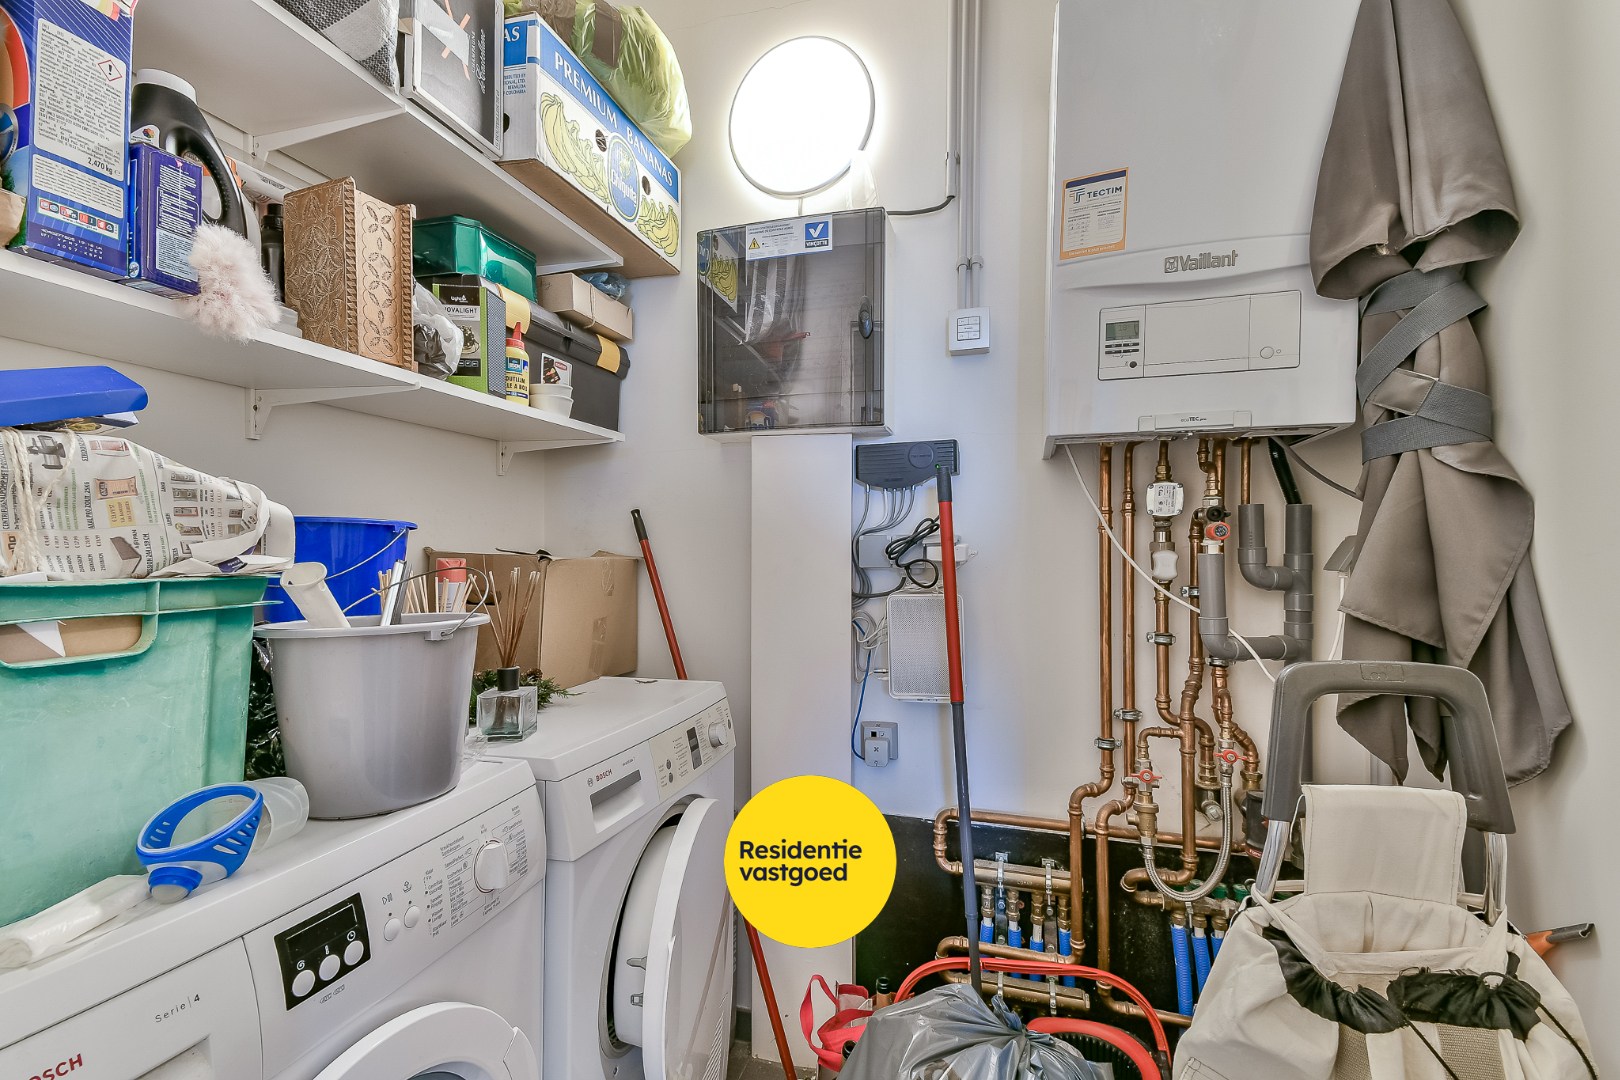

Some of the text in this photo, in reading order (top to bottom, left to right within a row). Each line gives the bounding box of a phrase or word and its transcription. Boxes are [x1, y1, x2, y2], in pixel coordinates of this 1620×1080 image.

[554, 51, 673, 187] PREMIUM BANANAS
[88, 156, 112, 175] 2,470 kg
[1087, 186, 1122, 198] TECTIM
[1180, 250, 1238, 272] Vaillant
[505, 376, 526, 384] OUTLIJM
[596, 768, 612, 782] BOSCH
[155, 994, 200, 1023] Serie 4
[28, 1053, 83, 1080] SCH
